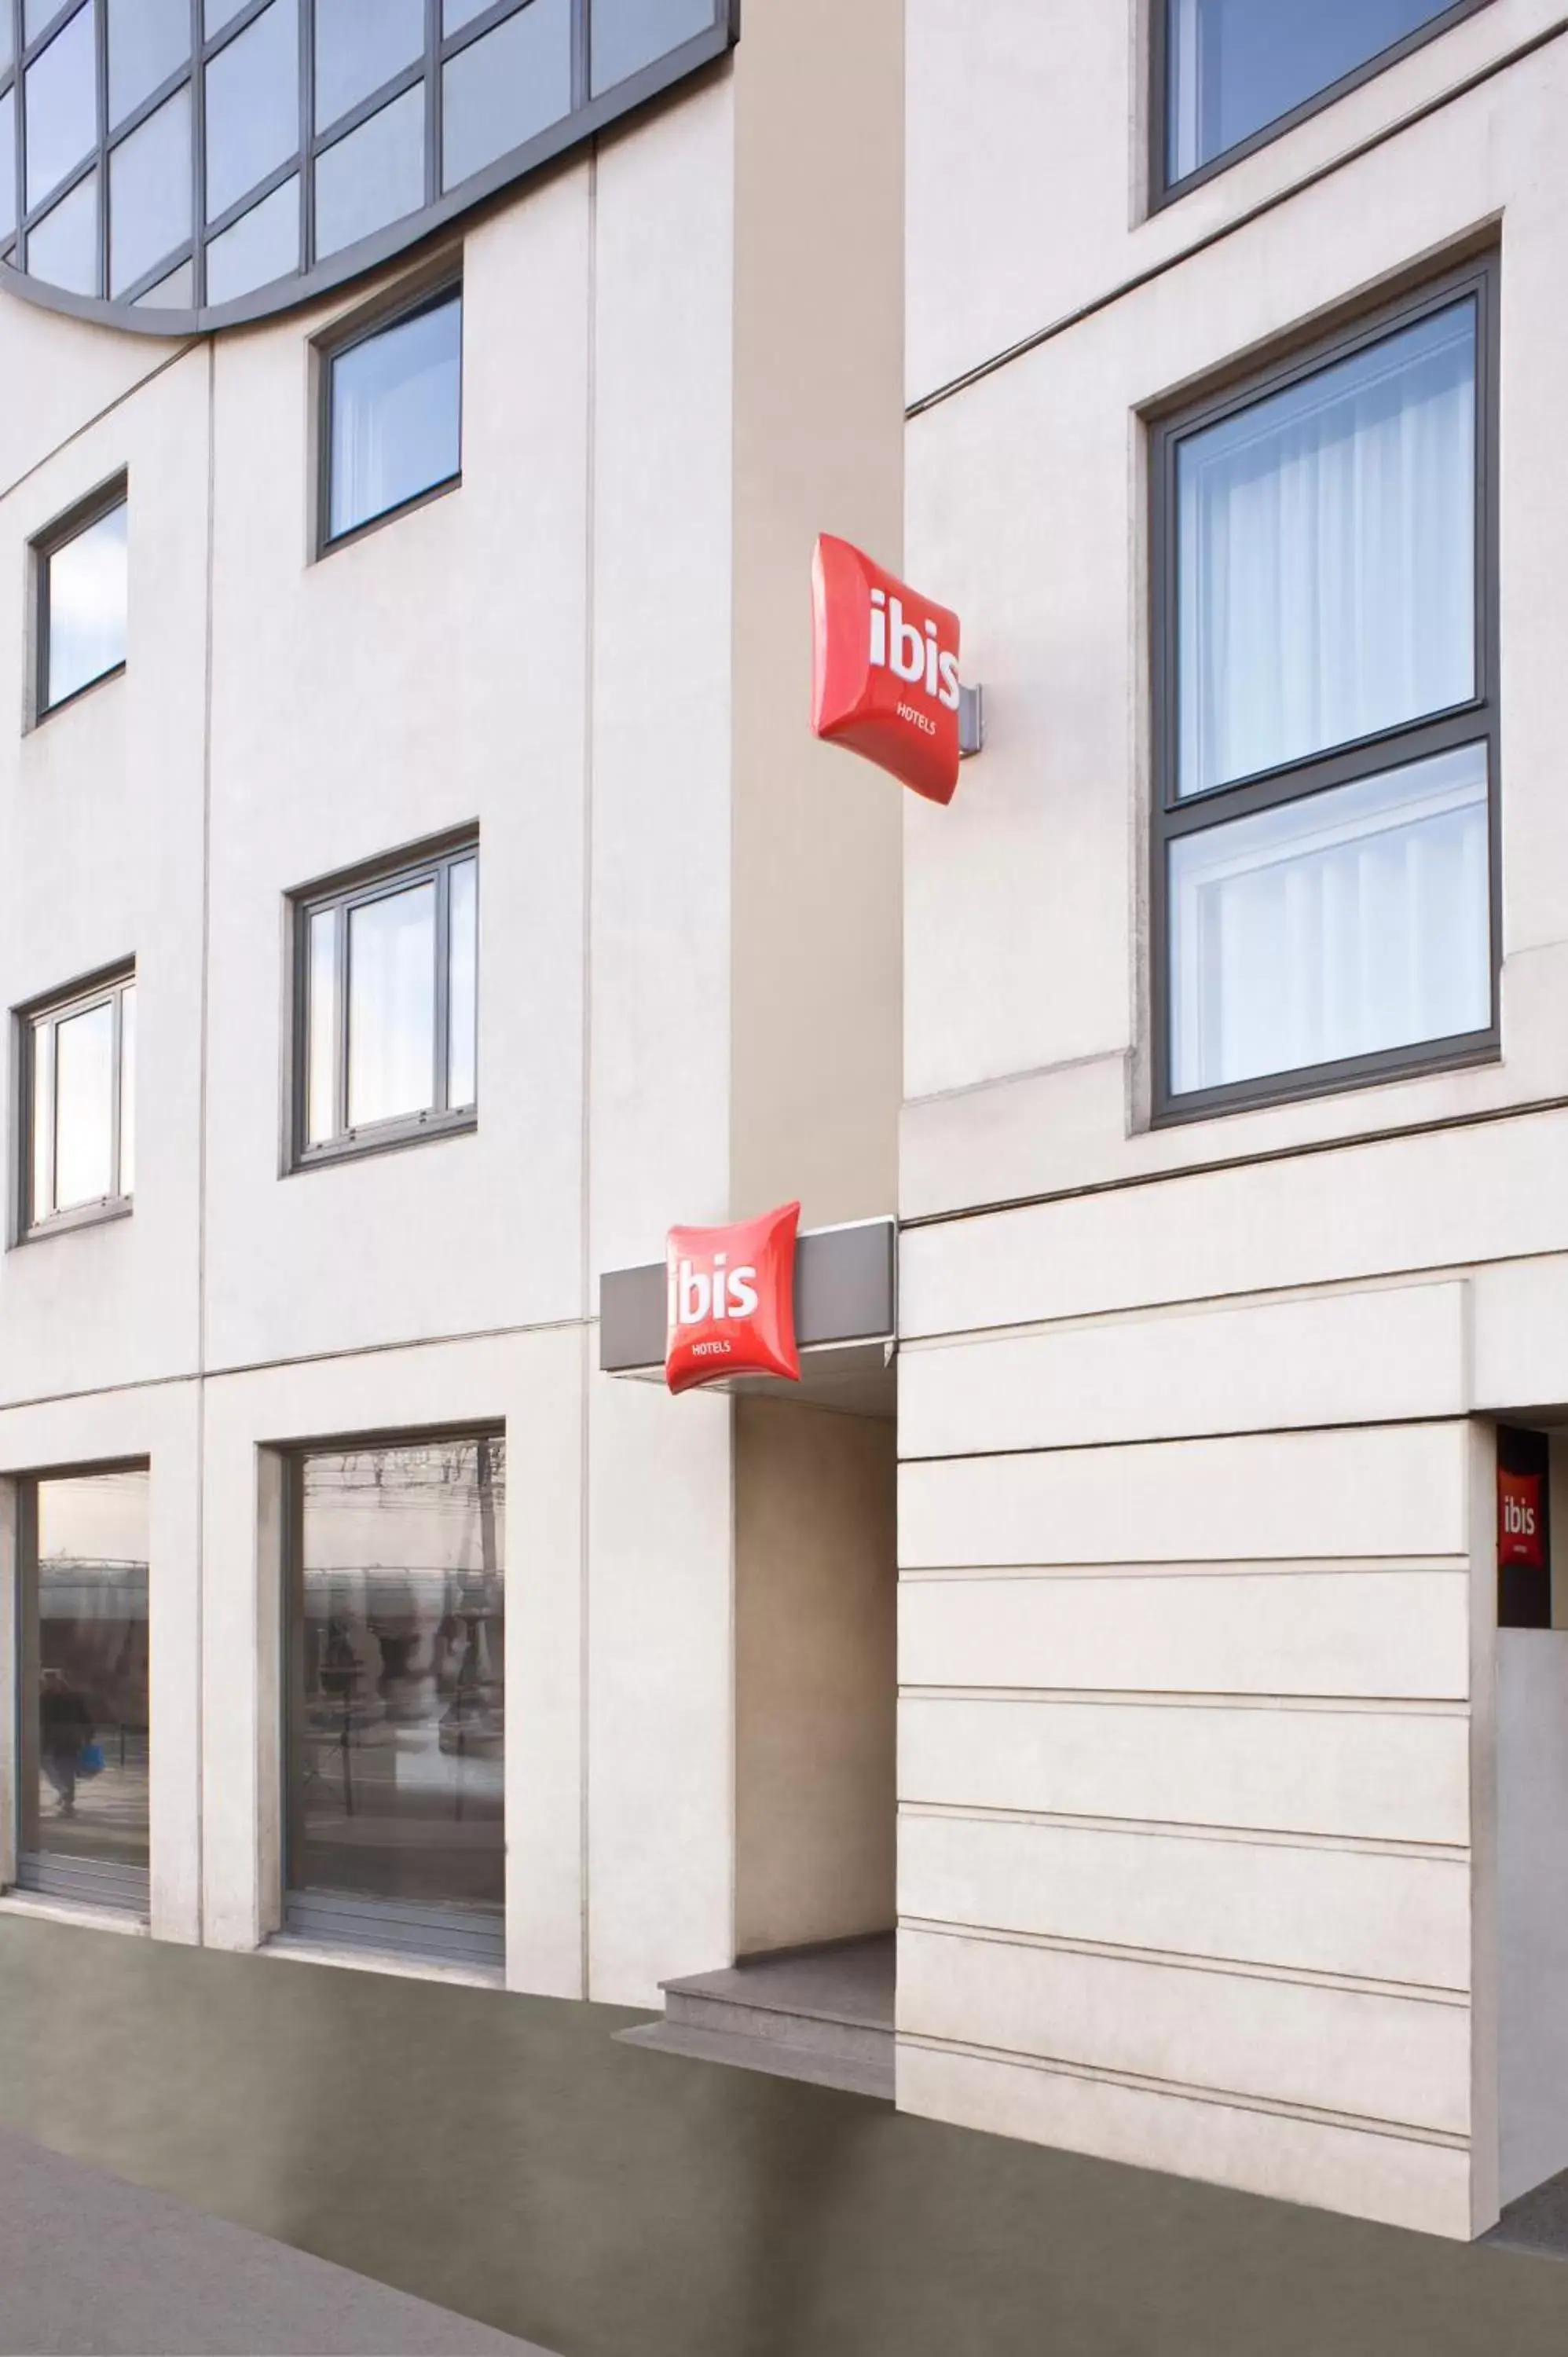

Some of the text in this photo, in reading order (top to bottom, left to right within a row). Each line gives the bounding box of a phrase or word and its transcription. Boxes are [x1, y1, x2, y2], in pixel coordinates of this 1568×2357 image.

[870, 588, 960, 711] ibis
[897, 702, 936, 735] HOTELS
[669, 1255, 759, 1327] ibis
[692, 1340, 731, 1355] HOTELS
[1504, 1495, 1535, 1535] ibis
